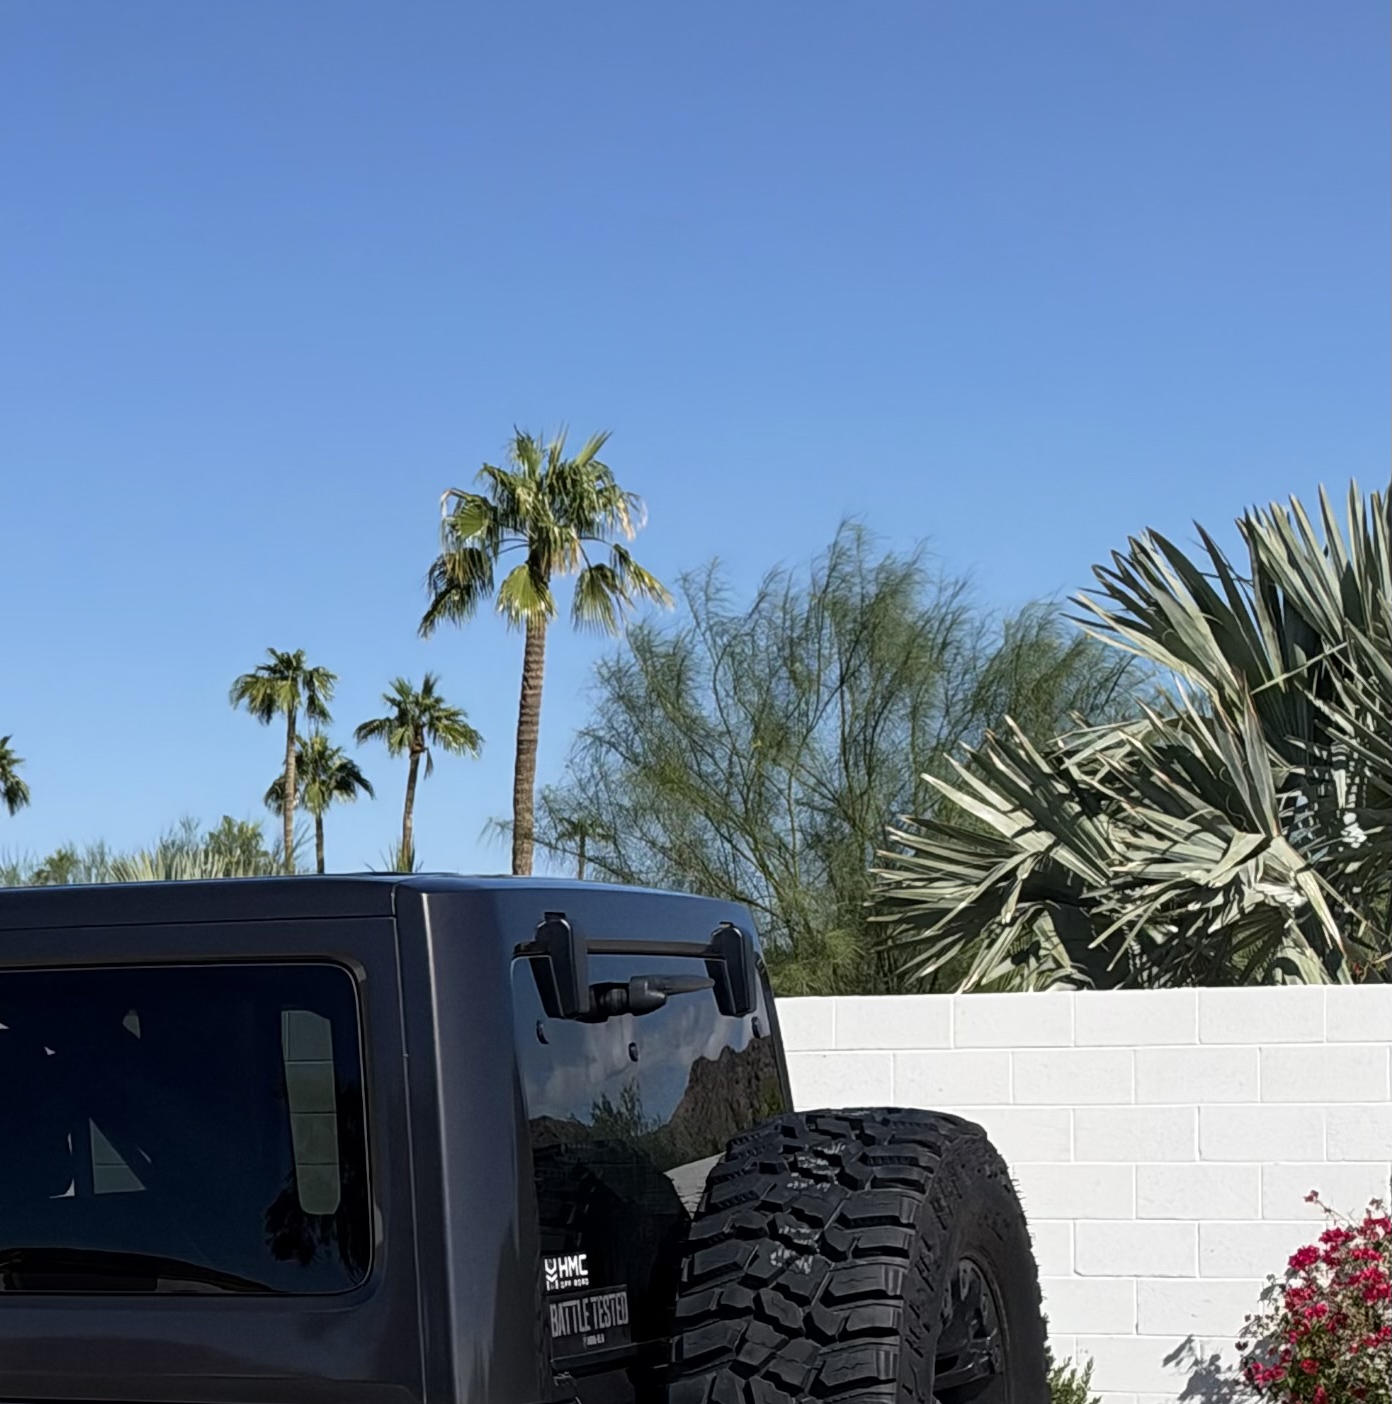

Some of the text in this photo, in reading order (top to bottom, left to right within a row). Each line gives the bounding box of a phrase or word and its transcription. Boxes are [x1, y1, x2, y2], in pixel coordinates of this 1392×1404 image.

[557, 1253, 589, 1279] HMC
[549, 1290, 629, 1338] BATTLE TESTED
